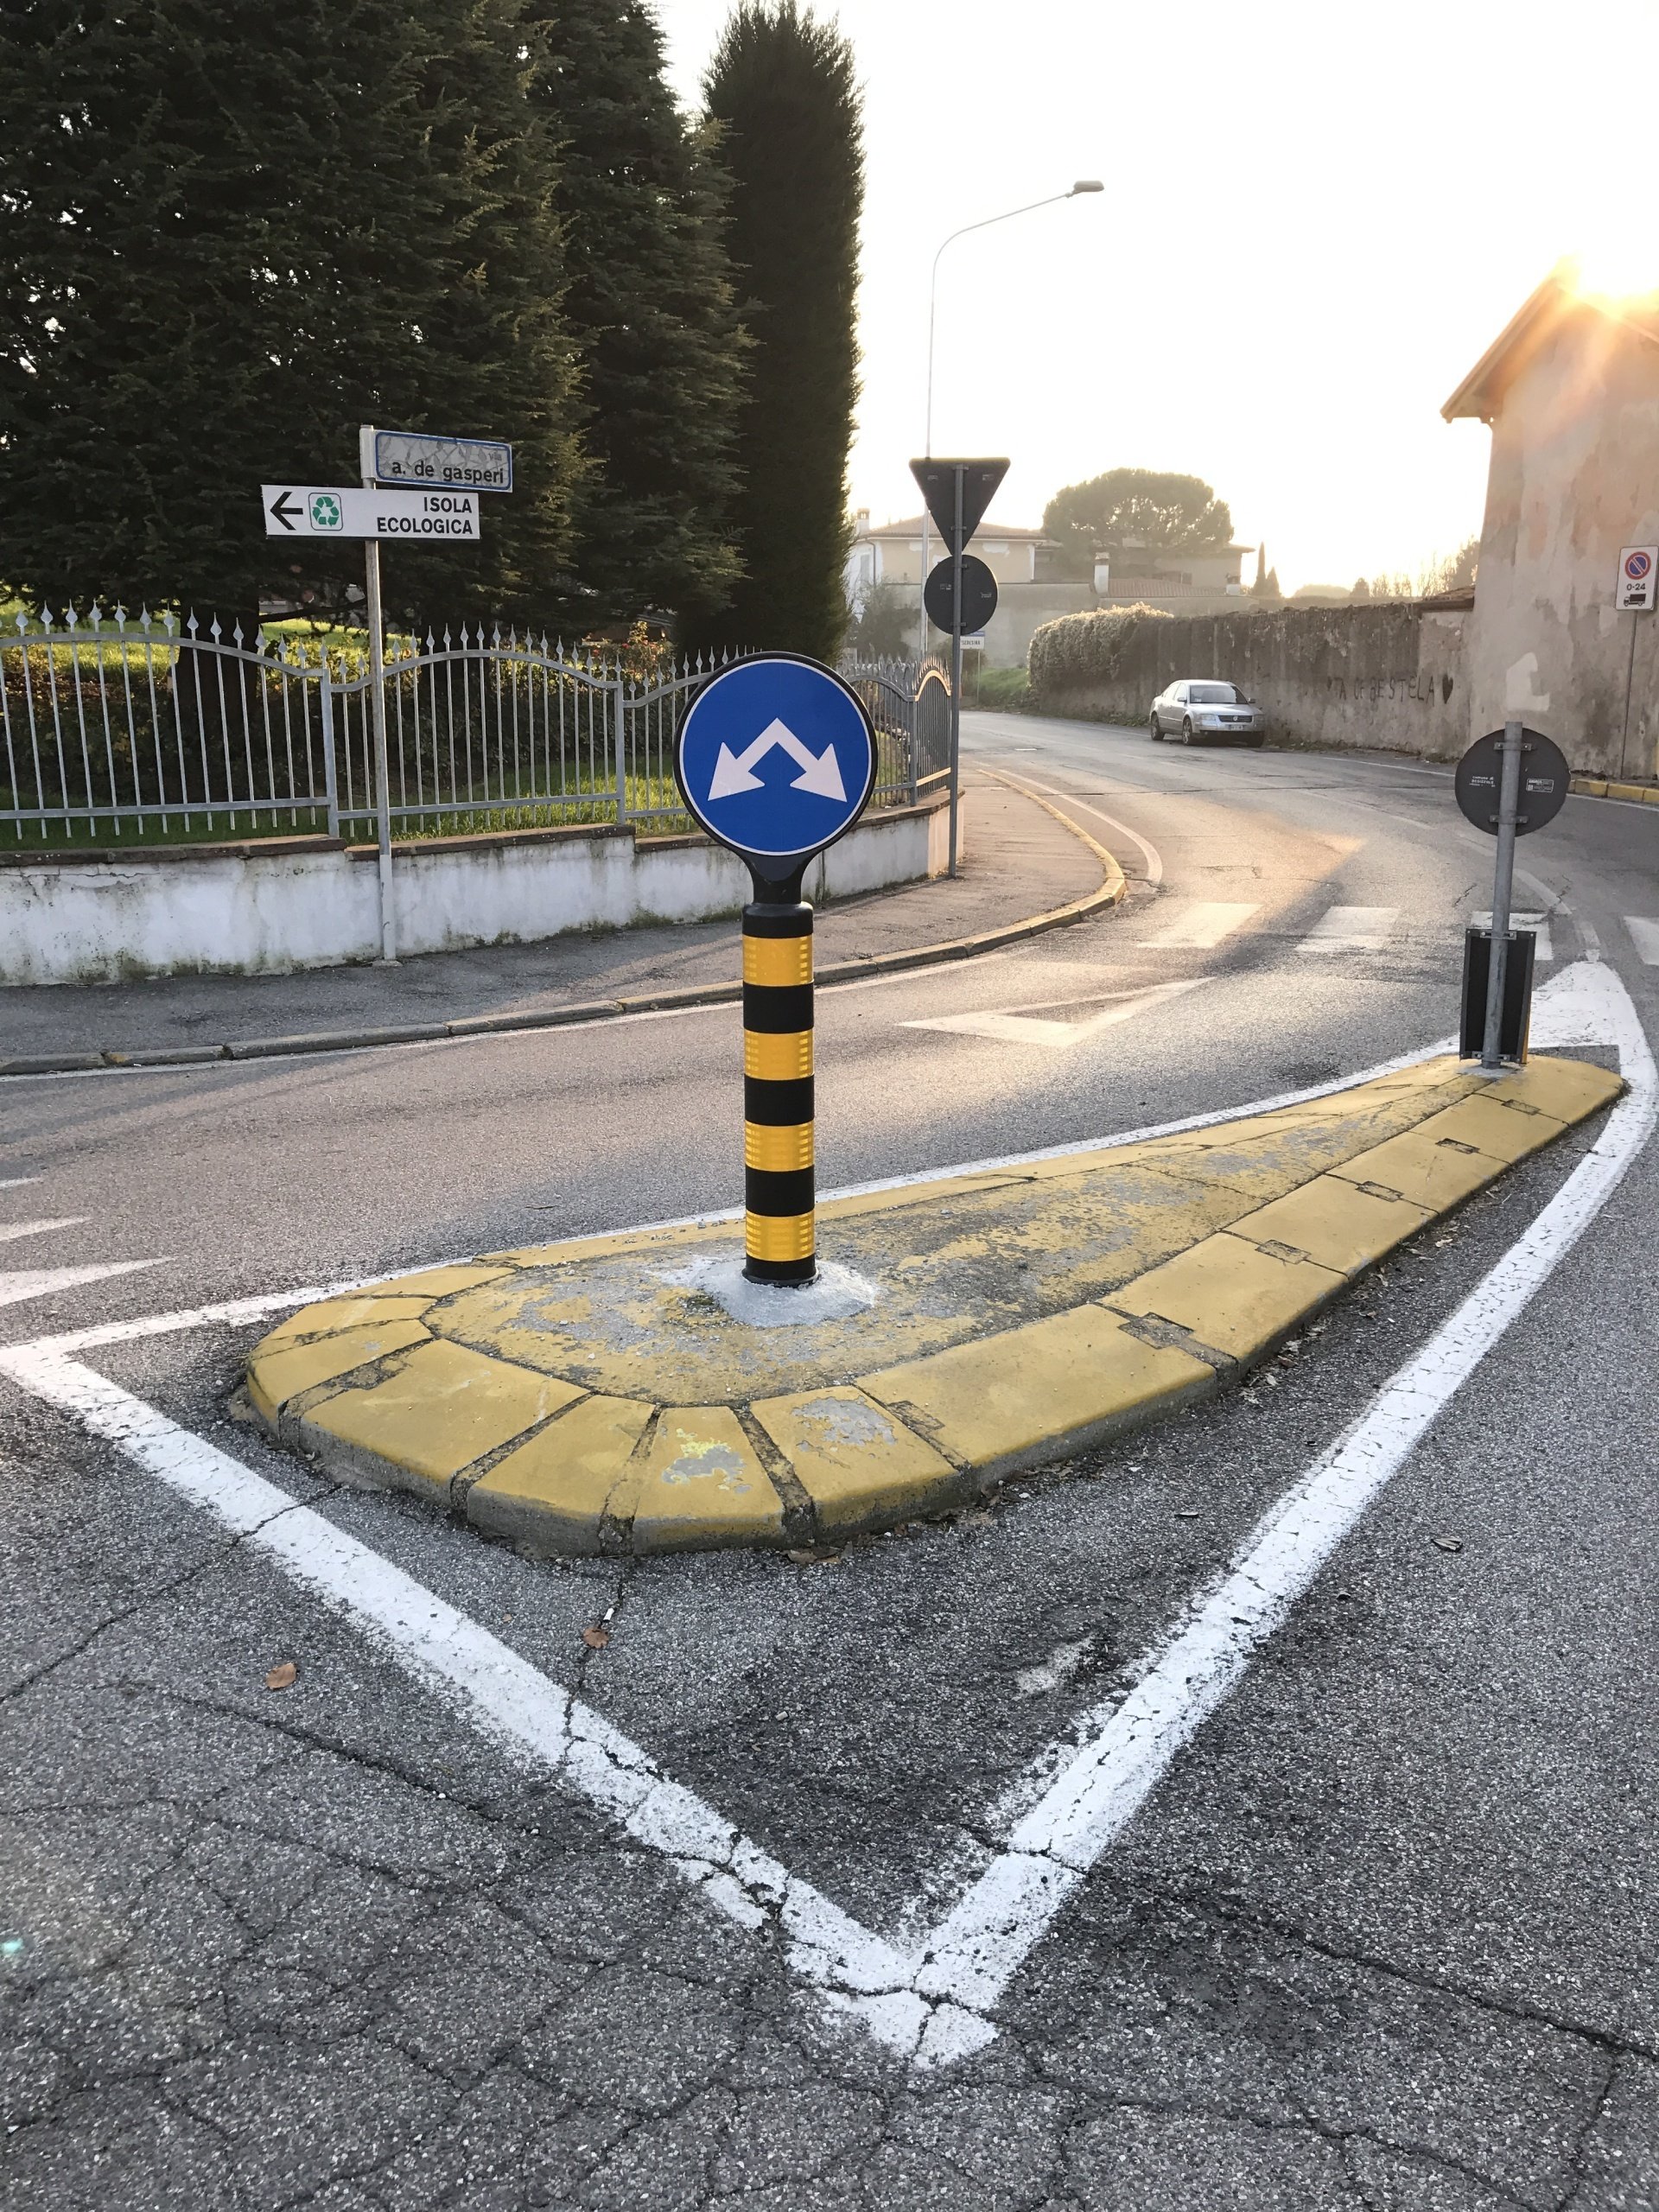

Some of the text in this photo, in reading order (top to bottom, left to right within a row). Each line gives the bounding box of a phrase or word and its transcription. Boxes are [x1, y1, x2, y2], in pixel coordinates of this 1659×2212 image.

[391, 460, 505, 485] a. de gasperi
[423, 496, 473, 513] ISOLA
[377, 517, 473, 534] ECOLOGICA
[1626, 582, 1646, 591] 0-24
